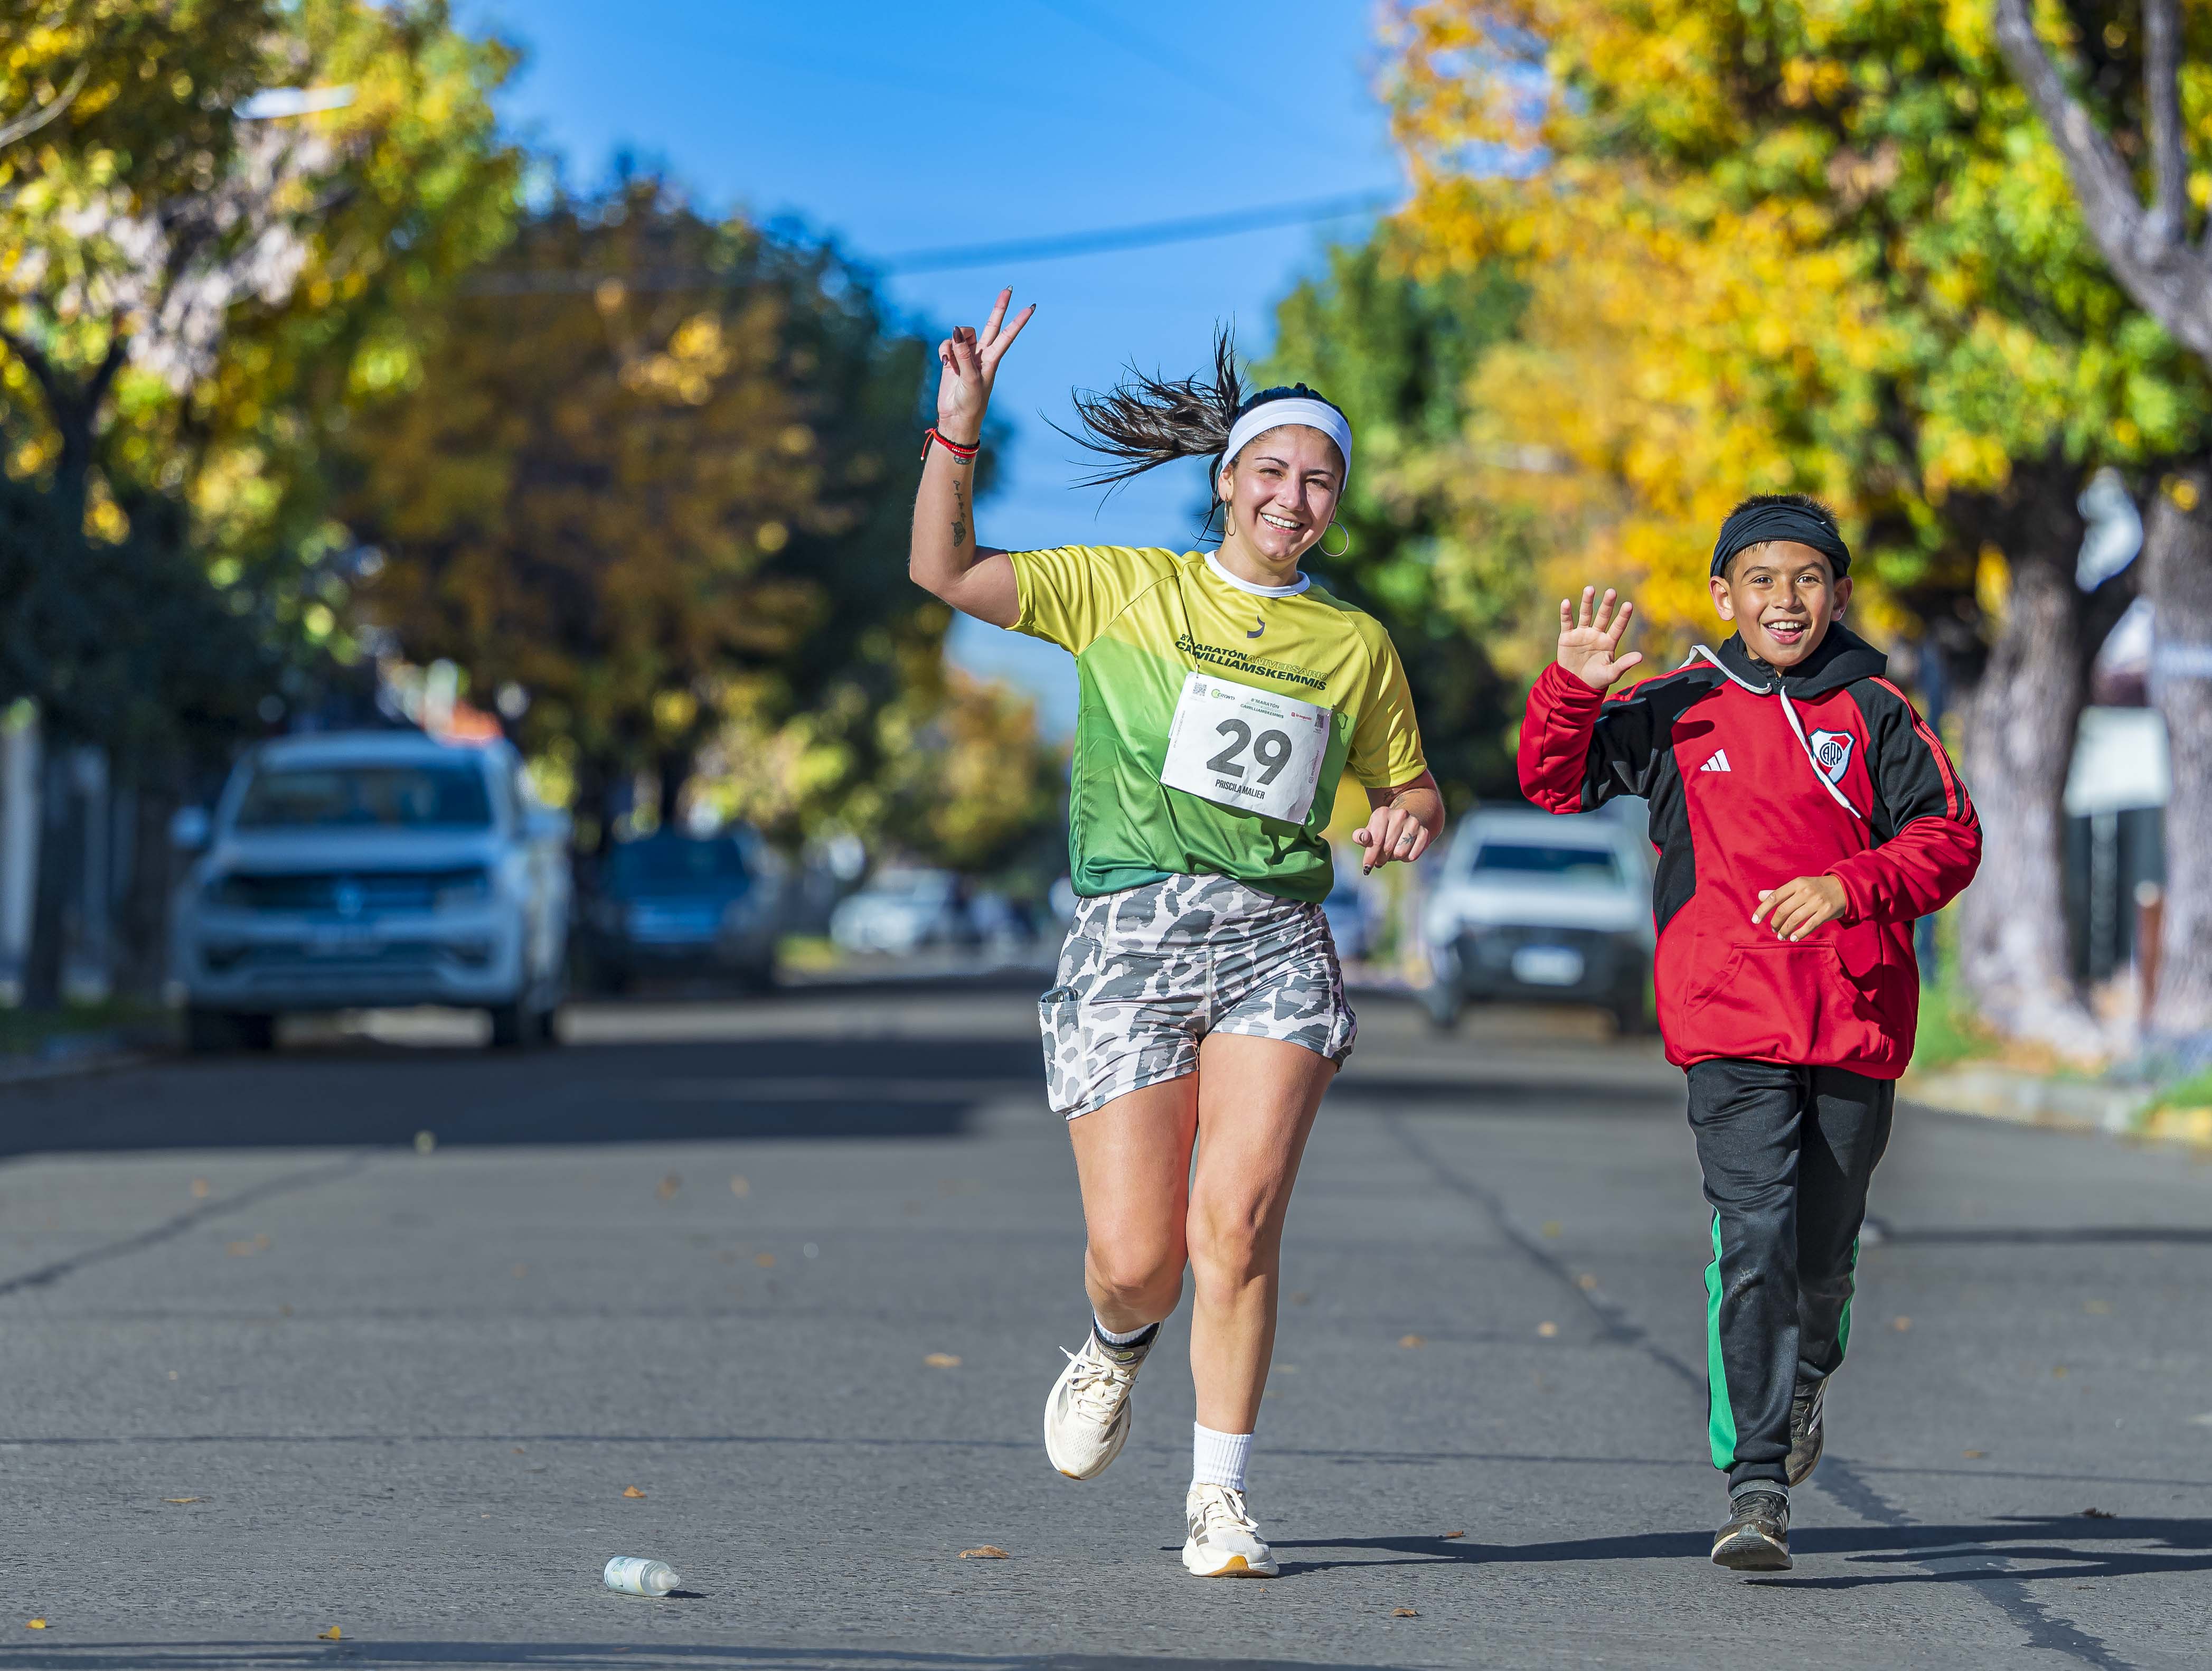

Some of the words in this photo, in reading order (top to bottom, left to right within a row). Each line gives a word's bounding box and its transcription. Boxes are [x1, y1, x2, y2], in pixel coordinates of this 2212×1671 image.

[1207, 719, 1292, 785] 29
[1215, 779, 1241, 793] PRISCILA
[1241, 785, 1265, 800] MALIER
